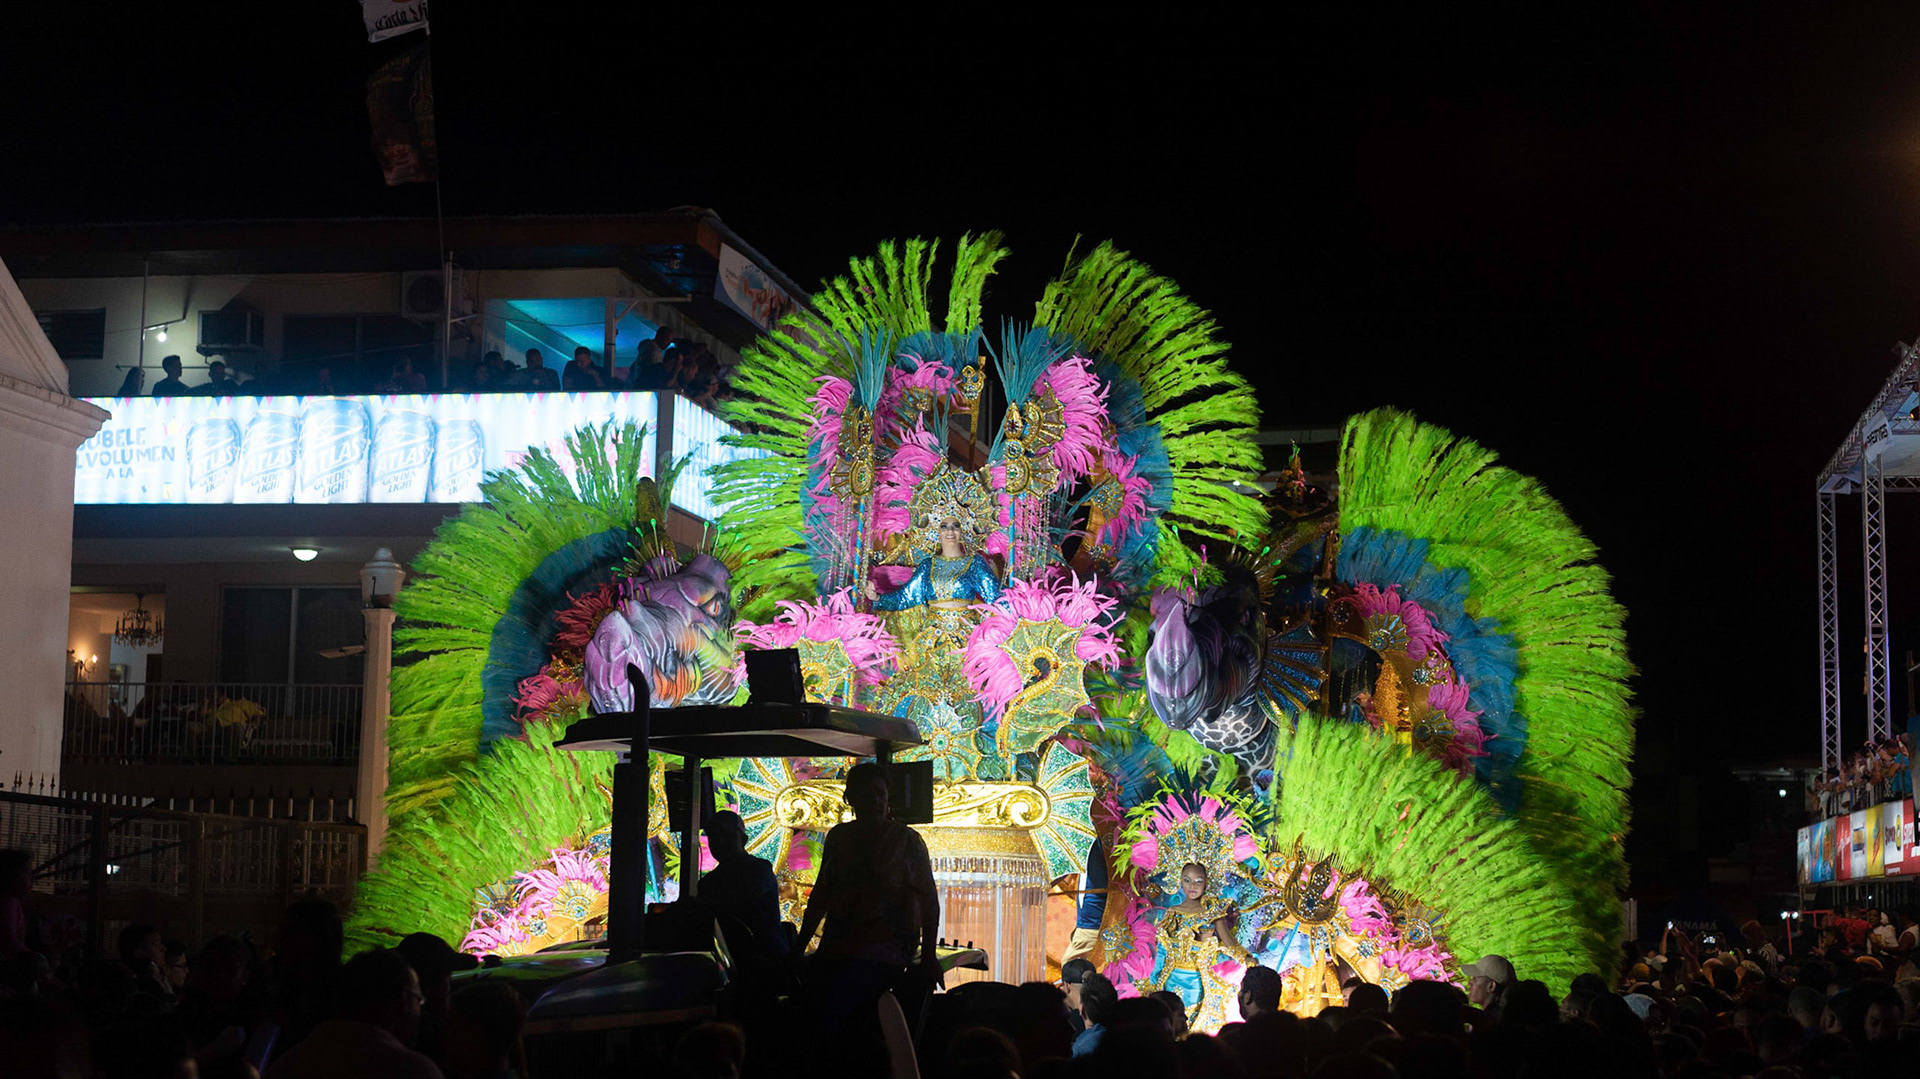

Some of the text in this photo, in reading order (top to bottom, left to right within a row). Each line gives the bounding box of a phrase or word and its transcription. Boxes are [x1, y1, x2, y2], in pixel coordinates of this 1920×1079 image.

[85, 446, 175, 469] VOLUMEN
[377, 445, 423, 475] ATLAS
[106, 467, 135, 480] A LA
[313, 467, 354, 491] GOLDEN
[322, 479, 349, 499] LIGHT
[388, 480, 412, 493] LIGHT
